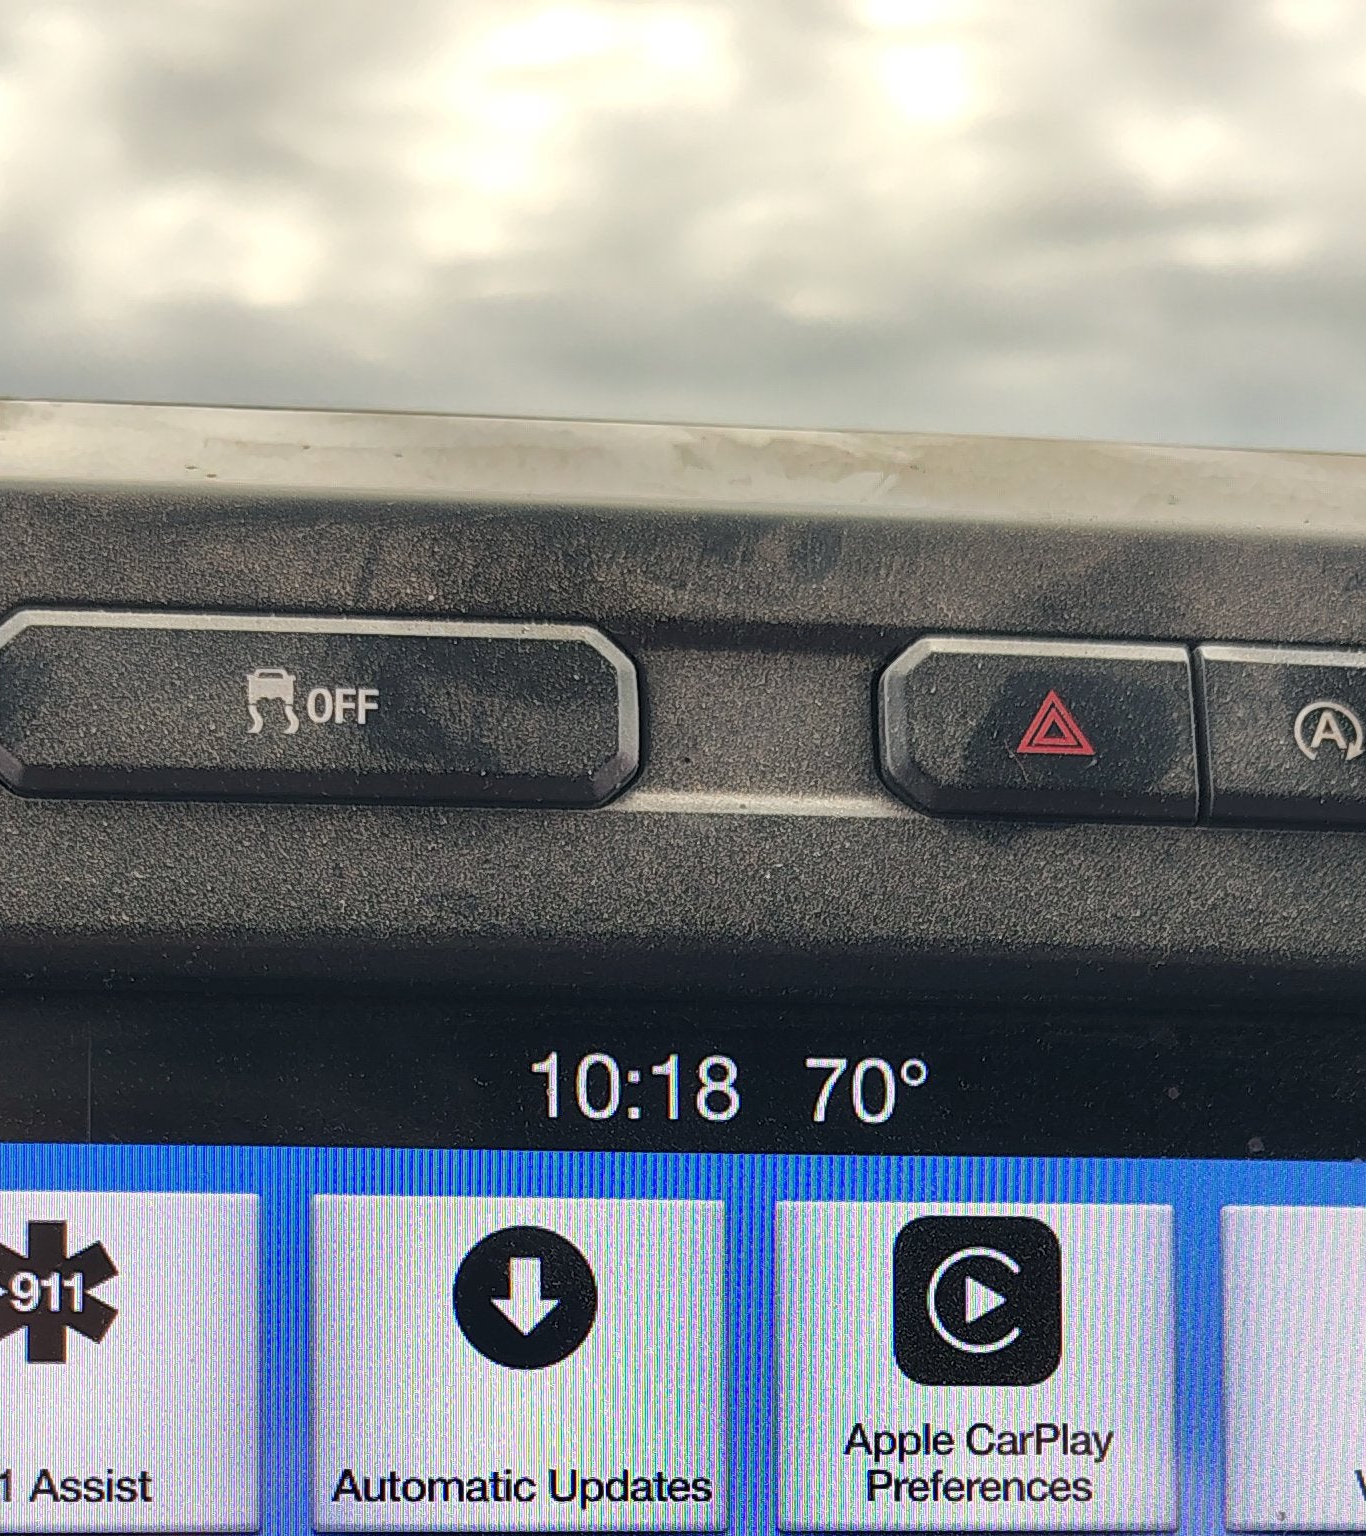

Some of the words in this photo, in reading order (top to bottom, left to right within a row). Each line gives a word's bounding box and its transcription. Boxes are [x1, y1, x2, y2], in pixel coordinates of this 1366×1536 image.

[306, 686, 379, 725] OFF
[532, 1051, 740, 1121] 10:18
[805, 1057, 927, 1124] 70°
[10, 1271, 83, 1312] 911
[843, 1422, 955, 1464] Apple
[965, 1422, 1114, 1464] CarPlay
[28, 1468, 153, 1503] Assist
[330, 1468, 536, 1503] Automatic
[548, 1468, 713, 1511] Updates
[866, 1468, 1093, 1503] Preferences
